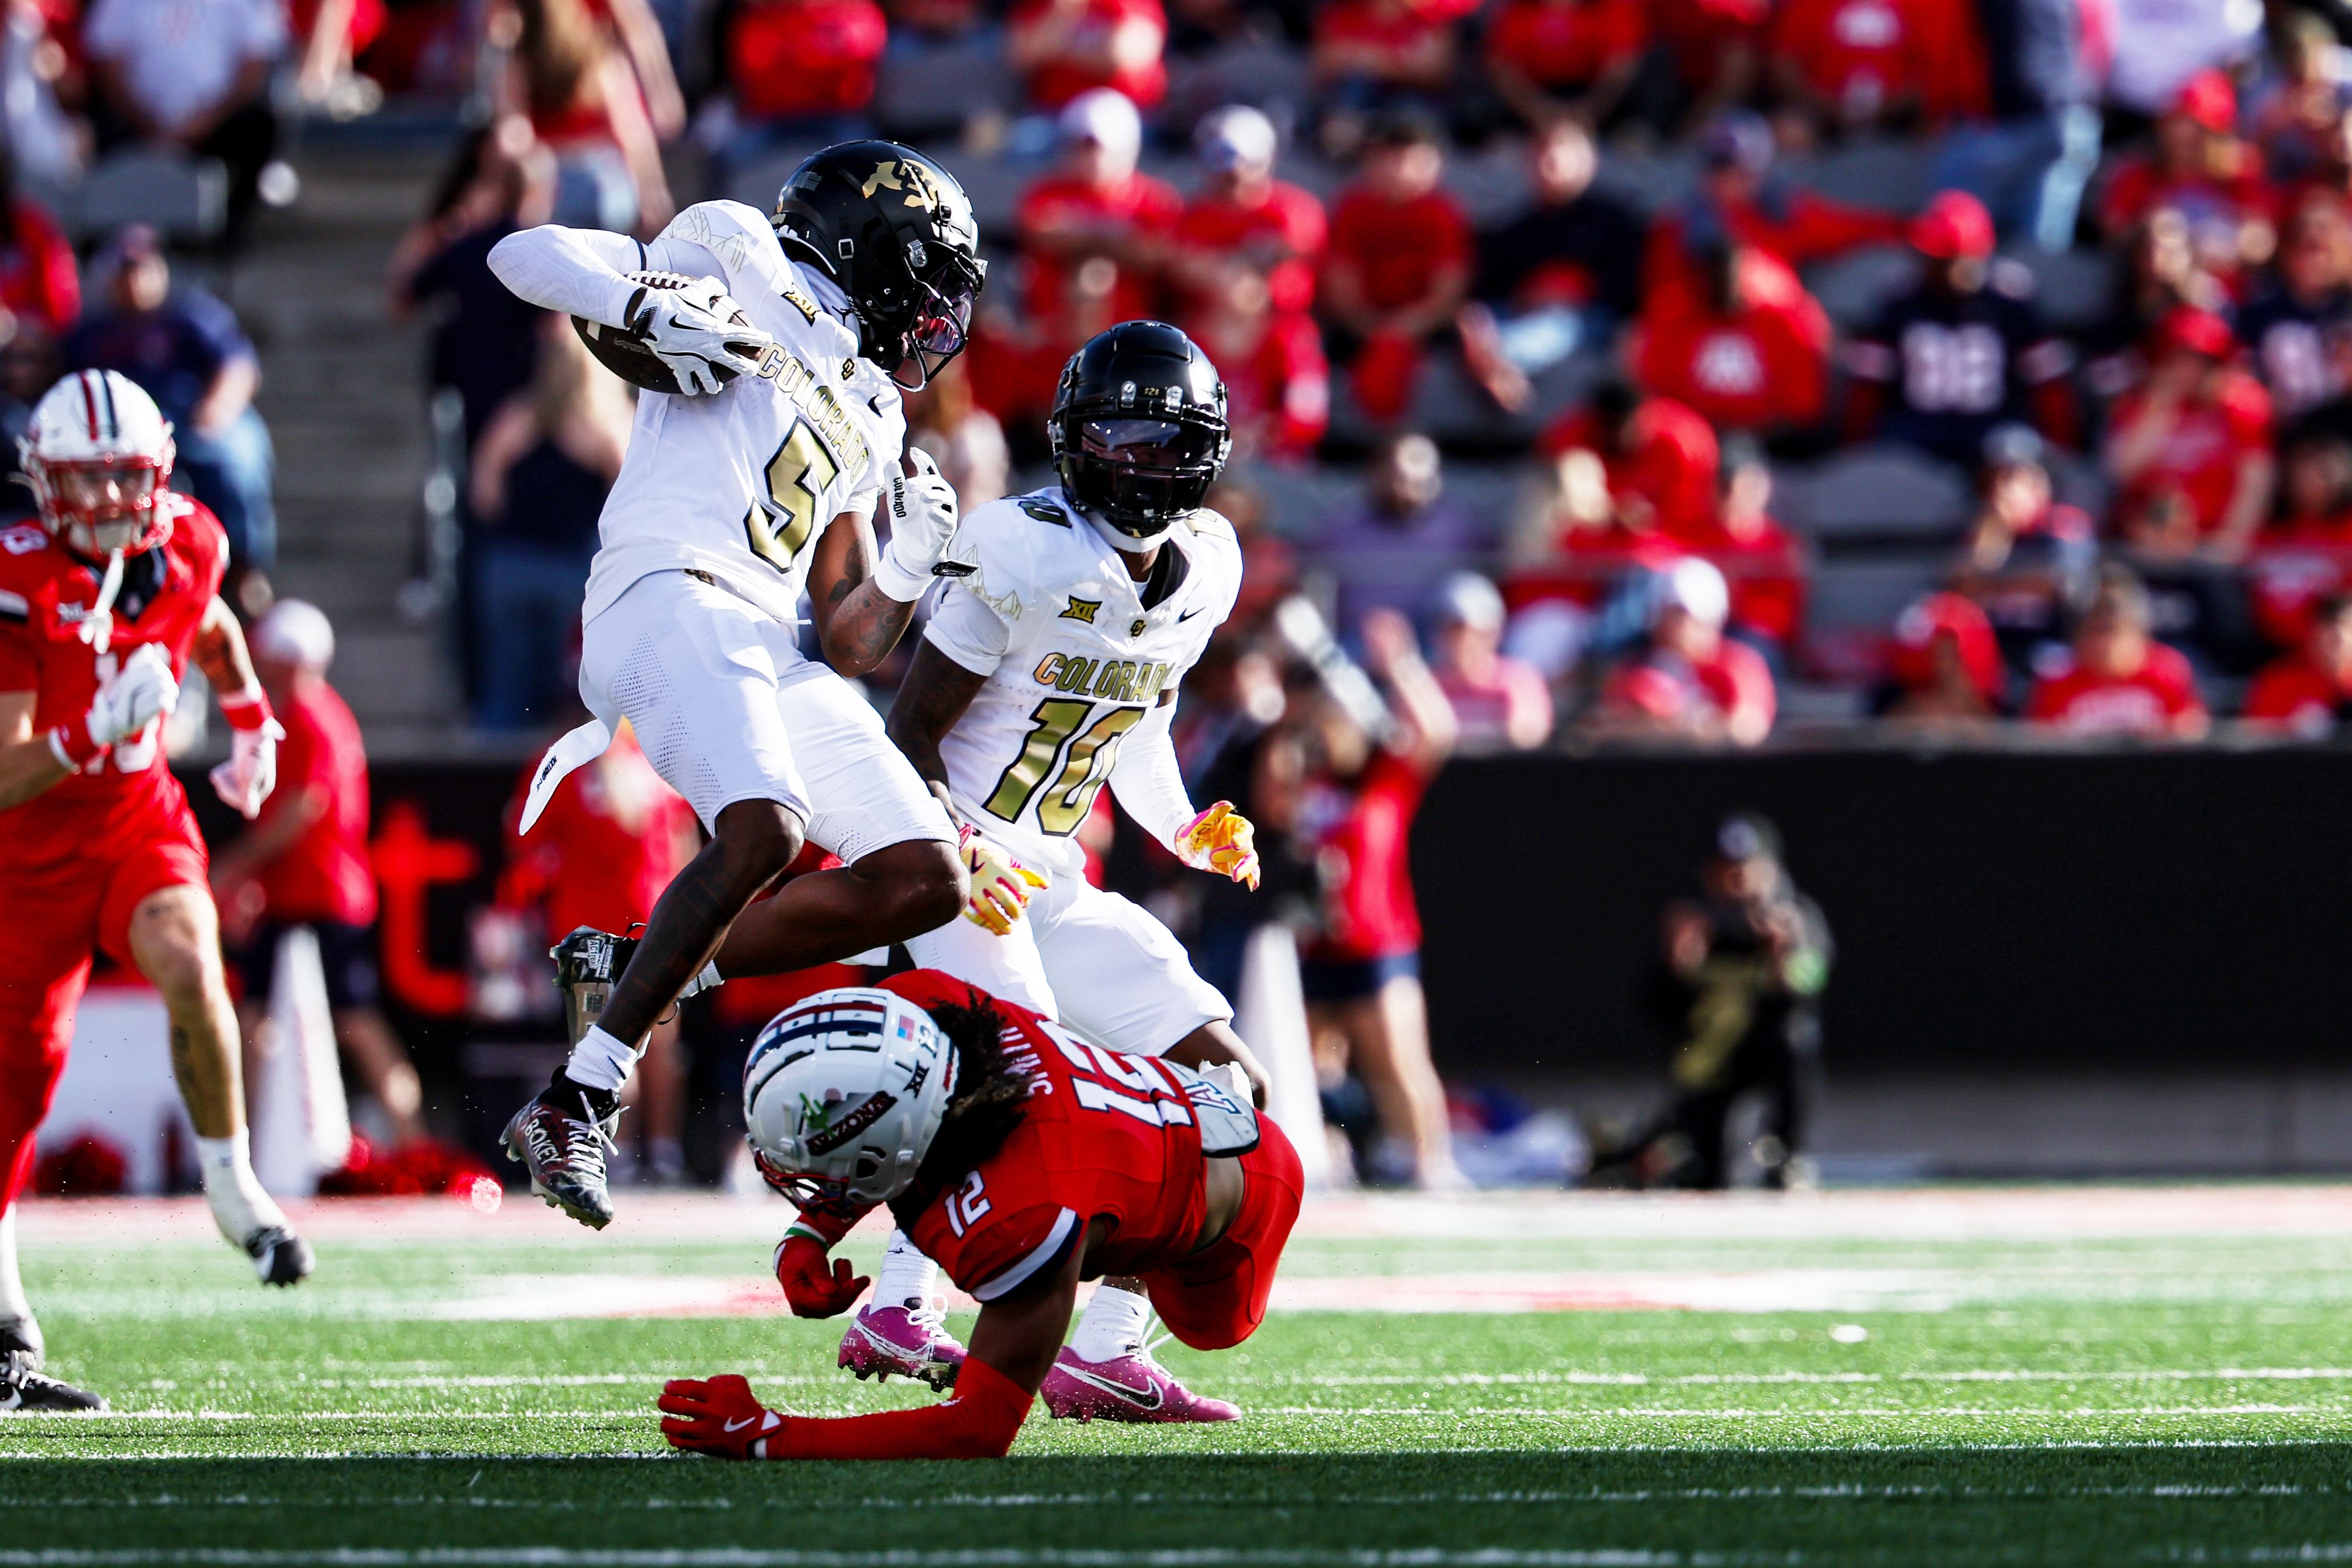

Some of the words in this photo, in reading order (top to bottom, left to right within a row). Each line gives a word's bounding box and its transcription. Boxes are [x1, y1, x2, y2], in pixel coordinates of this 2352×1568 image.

[757, 343, 869, 483] COLORADO
[743, 416, 840, 574] 5
[1058, 595, 1103, 624] XII
[1032, 652, 1175, 702] COLORAD
[980, 697, 1147, 837] 10
[1034, 1019, 1195, 1130] 12
[1182, 1081, 1243, 1115] A
[945, 1170, 992, 1239] 12
